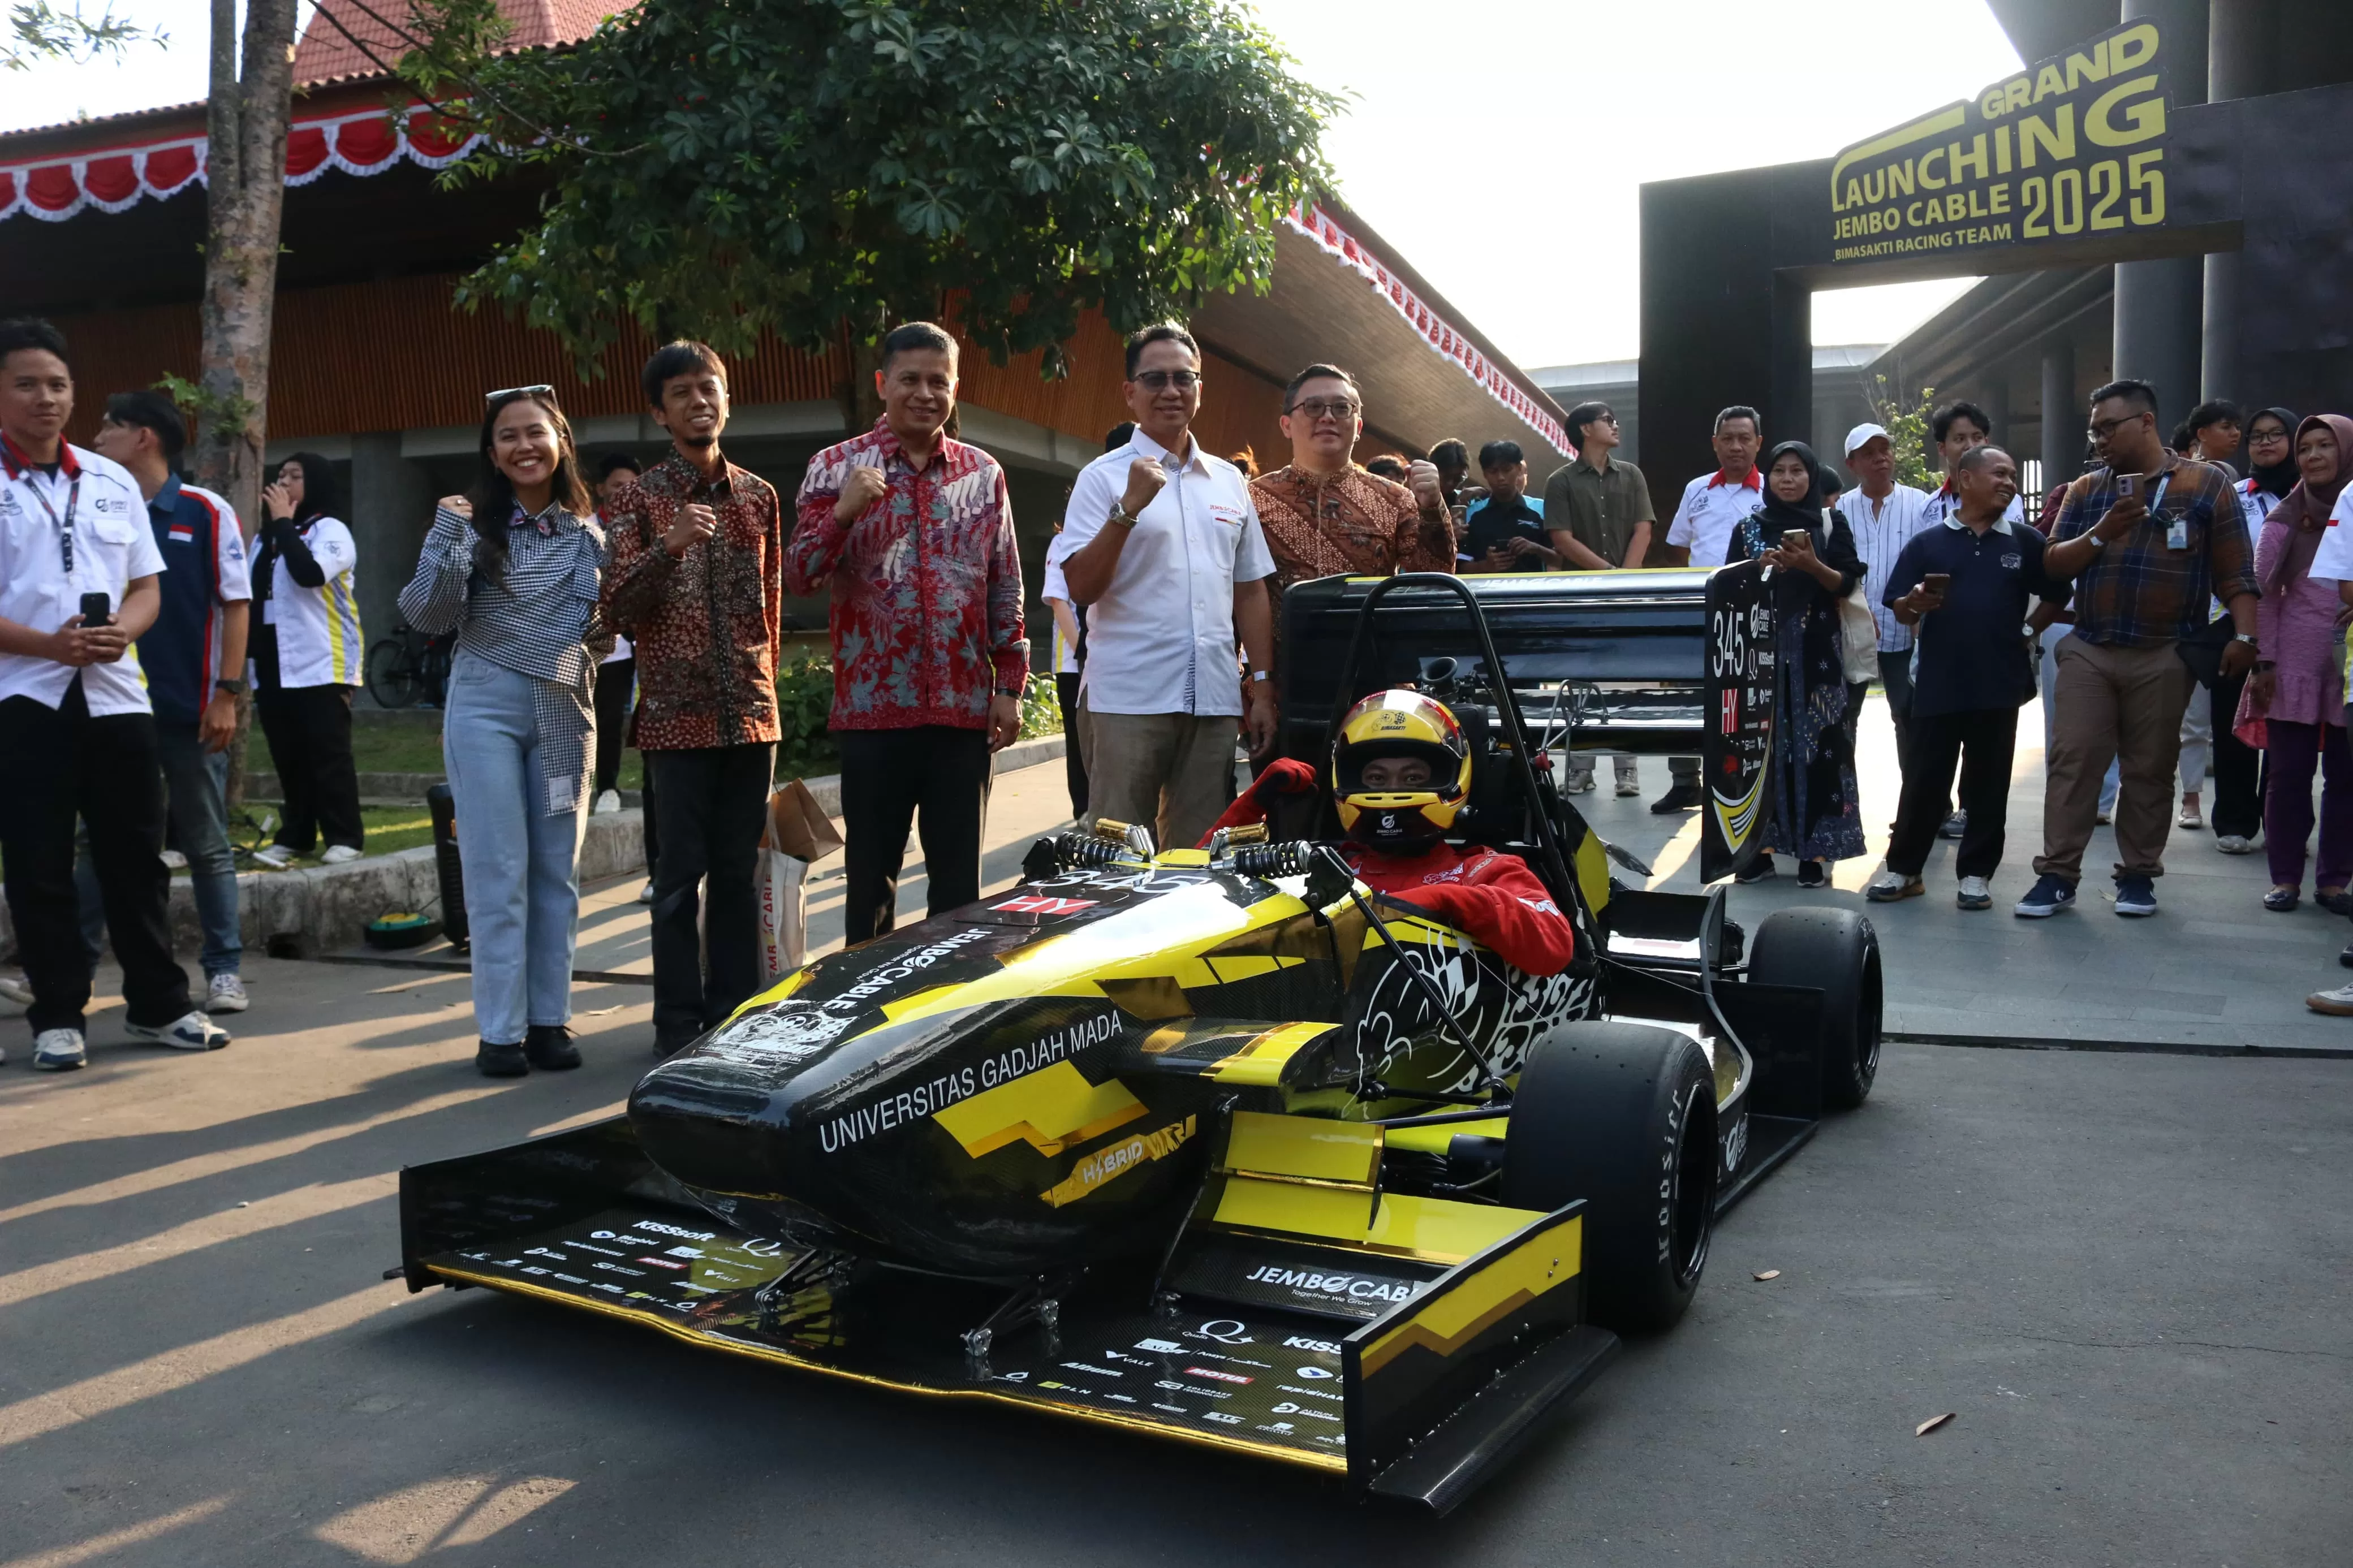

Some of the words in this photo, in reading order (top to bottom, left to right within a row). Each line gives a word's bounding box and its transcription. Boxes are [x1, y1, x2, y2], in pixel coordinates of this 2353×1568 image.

[1981, 23, 2159, 120] GRAND
[1830, 74, 2166, 213] LAUNCHING
[2021, 148, 2166, 239] 2025
[1833, 208, 1901, 240] JEMBO
[1907, 182, 2011, 227] CABLE
[1834, 241, 1894, 261] BIMASAKTI
[1896, 232, 1953, 253] RACING
[1955, 223, 2012, 245] TEAM
[1713, 610, 1744, 678] 345
[1721, 688, 1738, 735] HY
[988, 895, 1100, 915] HY
[820, 1066, 976, 1154] UNIVERSITAS
[981, 1034, 1065, 1088] GADJAH
[1069, 1009, 1123, 1053] MADA
[632, 1220, 716, 1242] KISSsoft
[643, 1295, 668, 1303] PLN
[1291, 1289, 1330, 1301] Together
[1347, 1298, 1373, 1307] Grow
[1182, 1331, 1209, 1340] Qualis
[1123, 1357, 1154, 1367] VALE
[1187, 1368, 1248, 1383] MOTUL
[1059, 1385, 1092, 1394] PLN
[1182, 1388, 1229, 1399] TECHNOLOGY
[1187, 1385, 1233, 1397] SOLIDBASE
